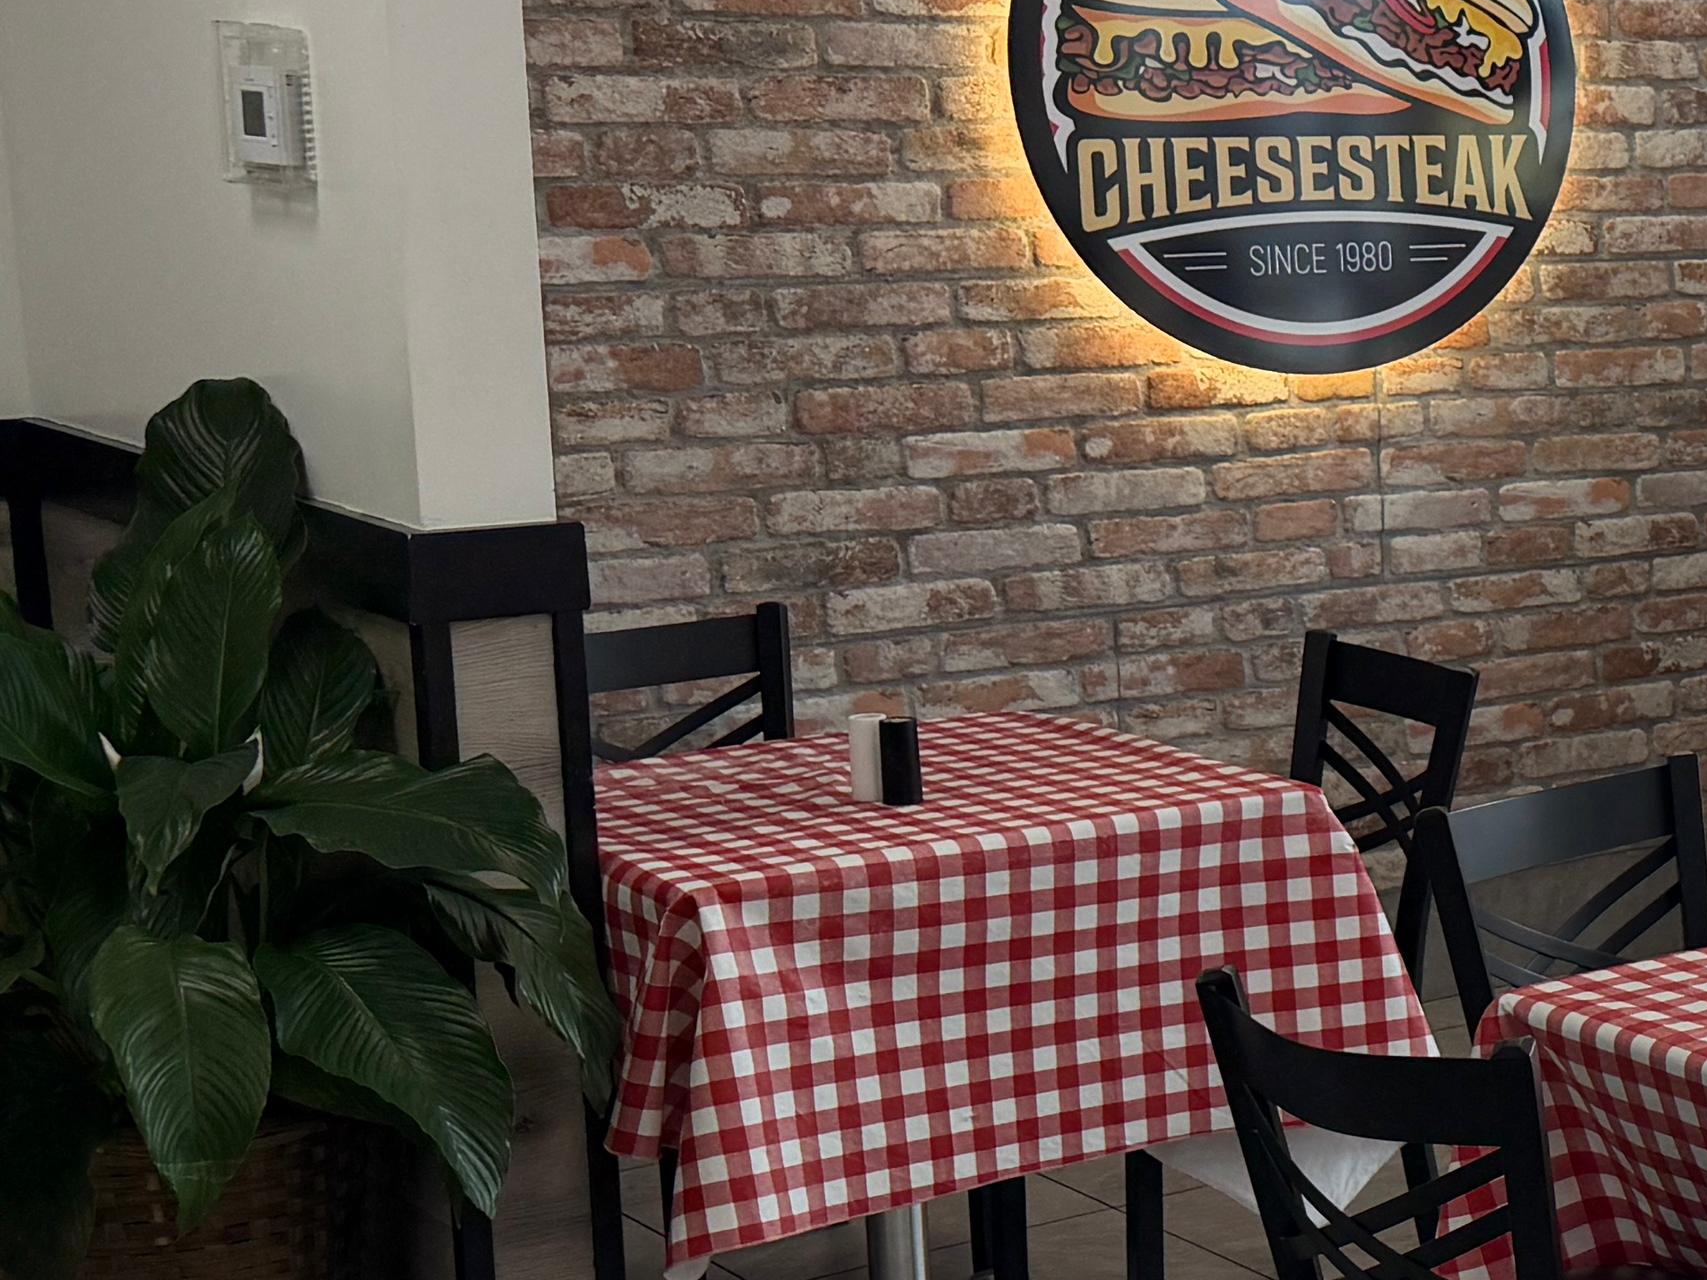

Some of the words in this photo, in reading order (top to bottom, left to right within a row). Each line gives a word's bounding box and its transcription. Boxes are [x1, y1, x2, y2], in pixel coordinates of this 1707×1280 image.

[1076, 133, 1533, 233] CHEESESTEAK
[1248, 243, 1328, 276] SINCE
[1336, 240, 1393, 272] 1980
